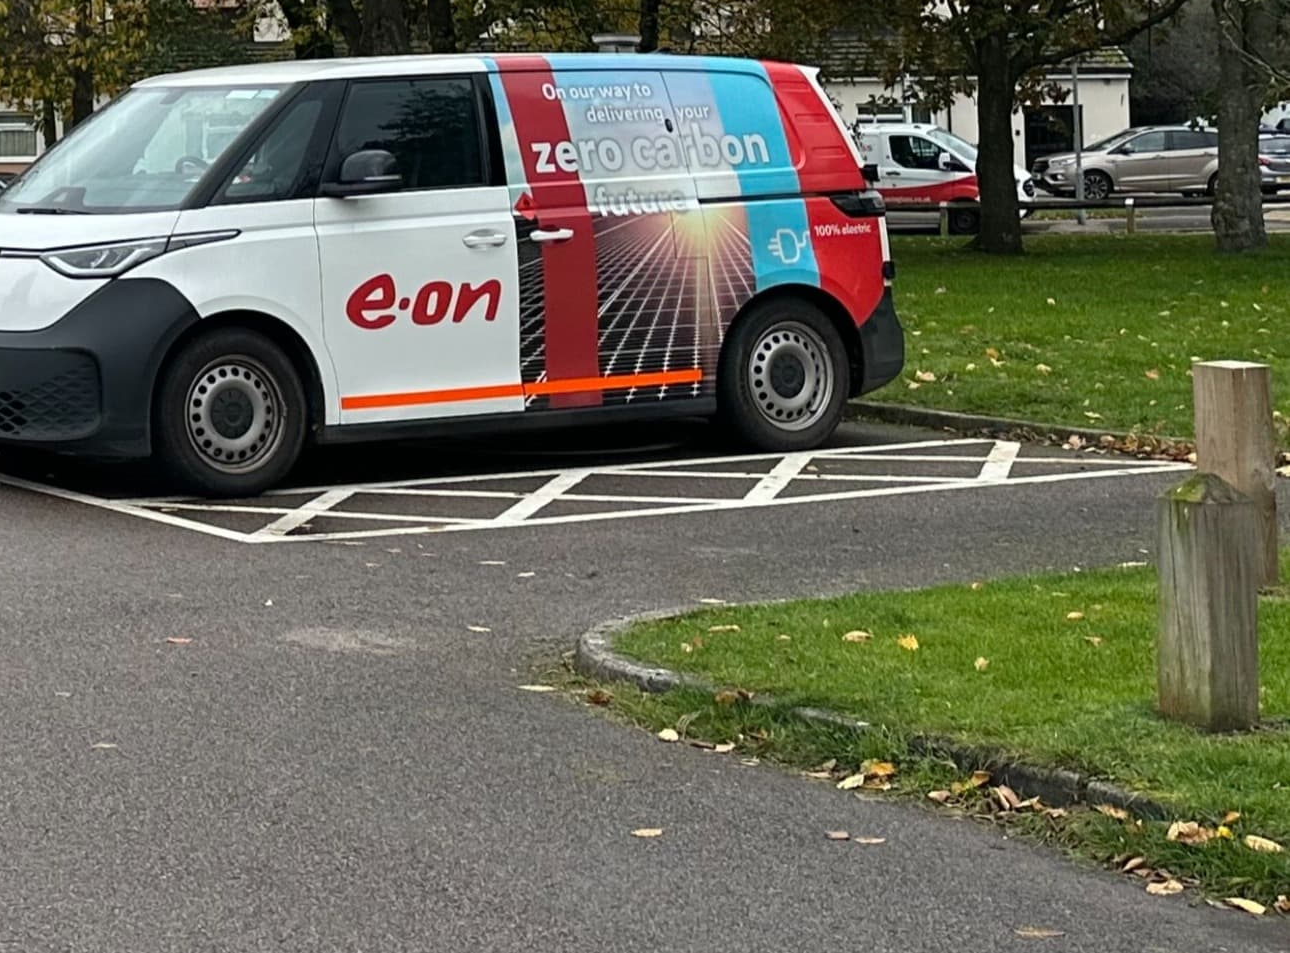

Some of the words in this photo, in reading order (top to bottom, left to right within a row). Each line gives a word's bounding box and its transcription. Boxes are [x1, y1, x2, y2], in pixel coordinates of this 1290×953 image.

[542, 83, 566, 100] On
[569, 86, 596, 99] our
[599, 85, 632, 101] way
[633, 82, 651, 97] to
[587, 105, 663, 124] delivering
[675, 105, 710, 121] your
[530, 136, 623, 173] zero
[632, 123, 770, 169] carbon
[595, 185, 687, 216] future
[814, 224, 841, 236] 100%
[842, 222, 871, 235] electric
